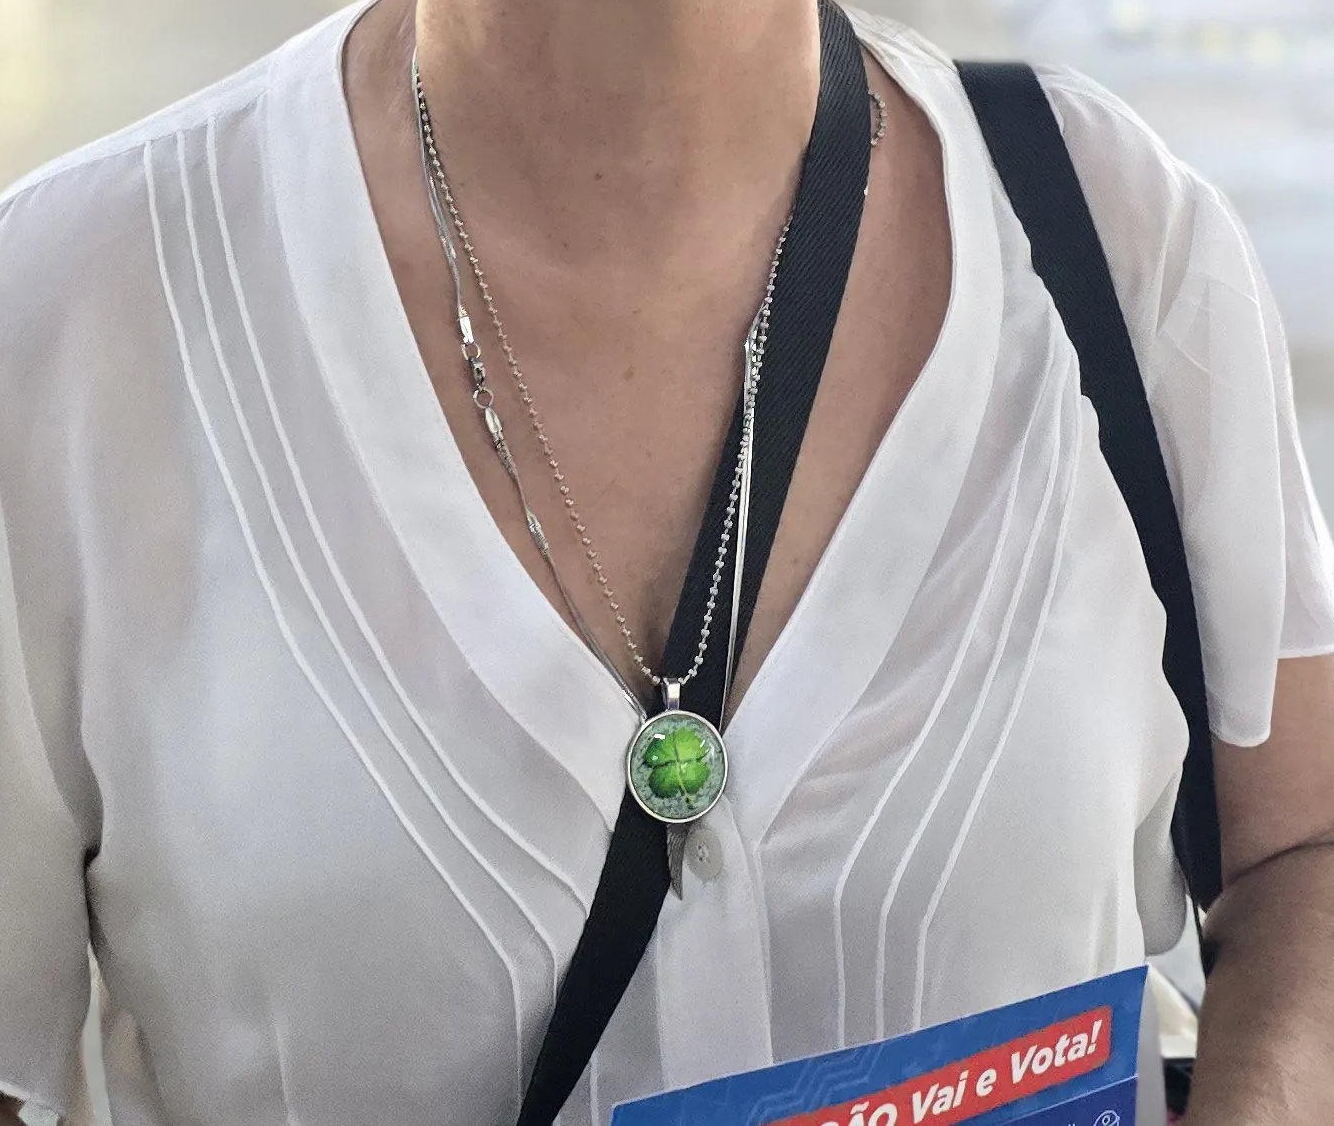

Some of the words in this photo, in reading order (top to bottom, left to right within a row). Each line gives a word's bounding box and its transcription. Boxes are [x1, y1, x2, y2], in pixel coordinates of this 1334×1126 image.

[820, 1101, 898, 1126] ÃO
[912, 1070, 969, 1124] Vai
[975, 1068, 997, 1097] e
[1011, 1019, 1103, 1084] Vota!
